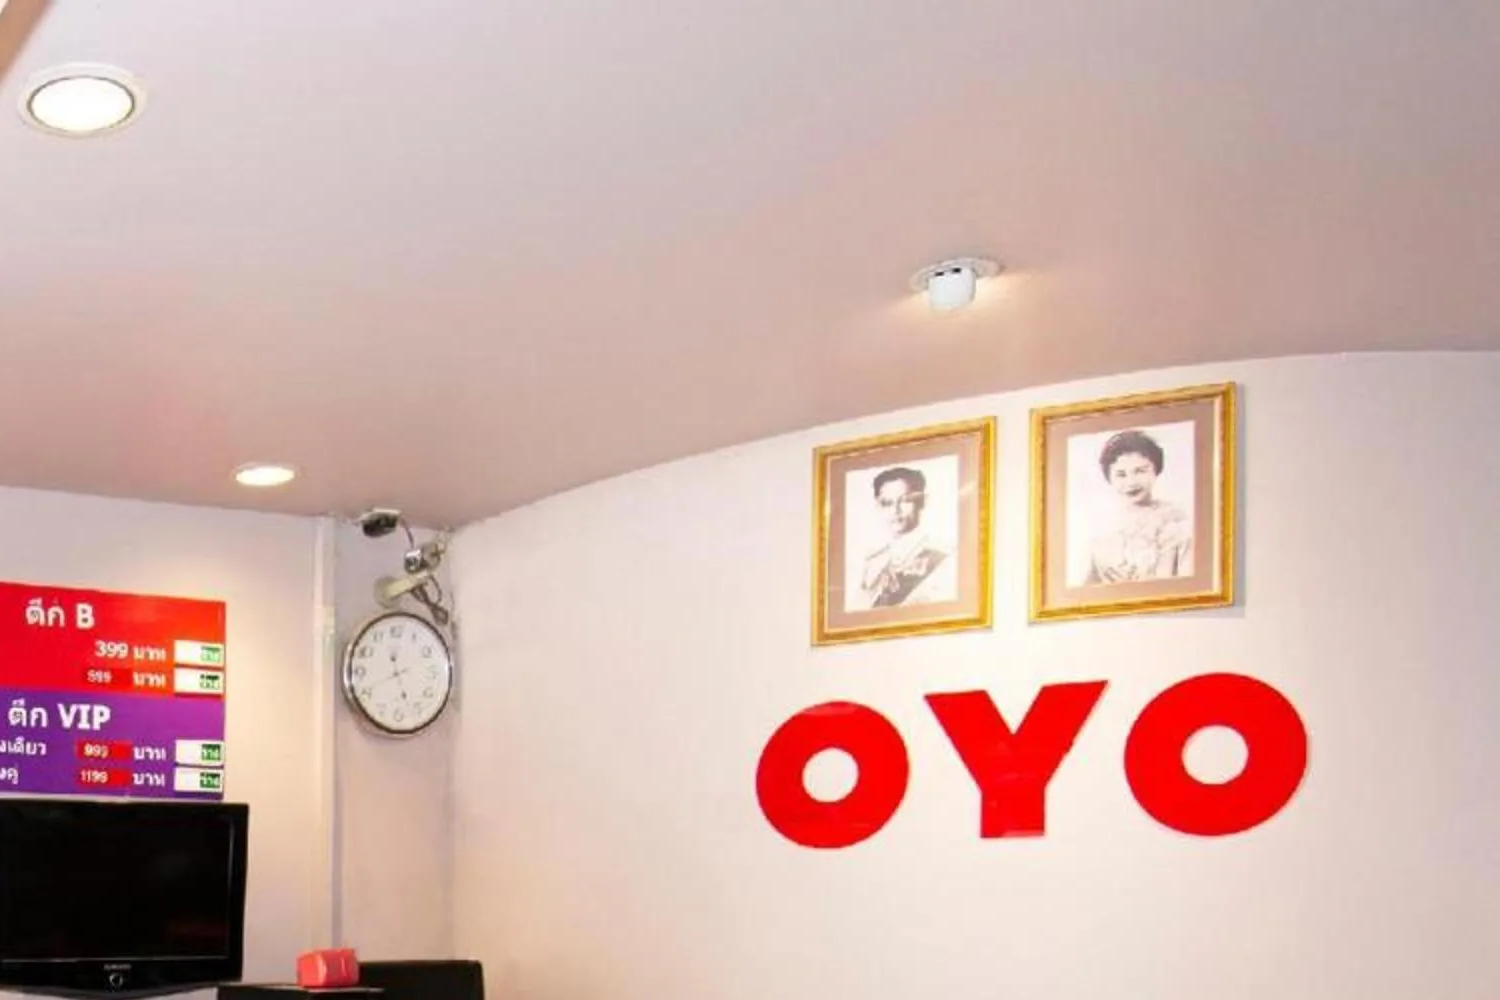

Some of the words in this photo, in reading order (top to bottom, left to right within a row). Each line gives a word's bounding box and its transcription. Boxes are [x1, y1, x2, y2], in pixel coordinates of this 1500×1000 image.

[76, 603, 95, 629] B
[95, 640, 129, 659] 399
[8, 698, 48, 727] ตึก
[57, 704, 111, 730] VIP
[756, 672, 1308, 849] OYO
